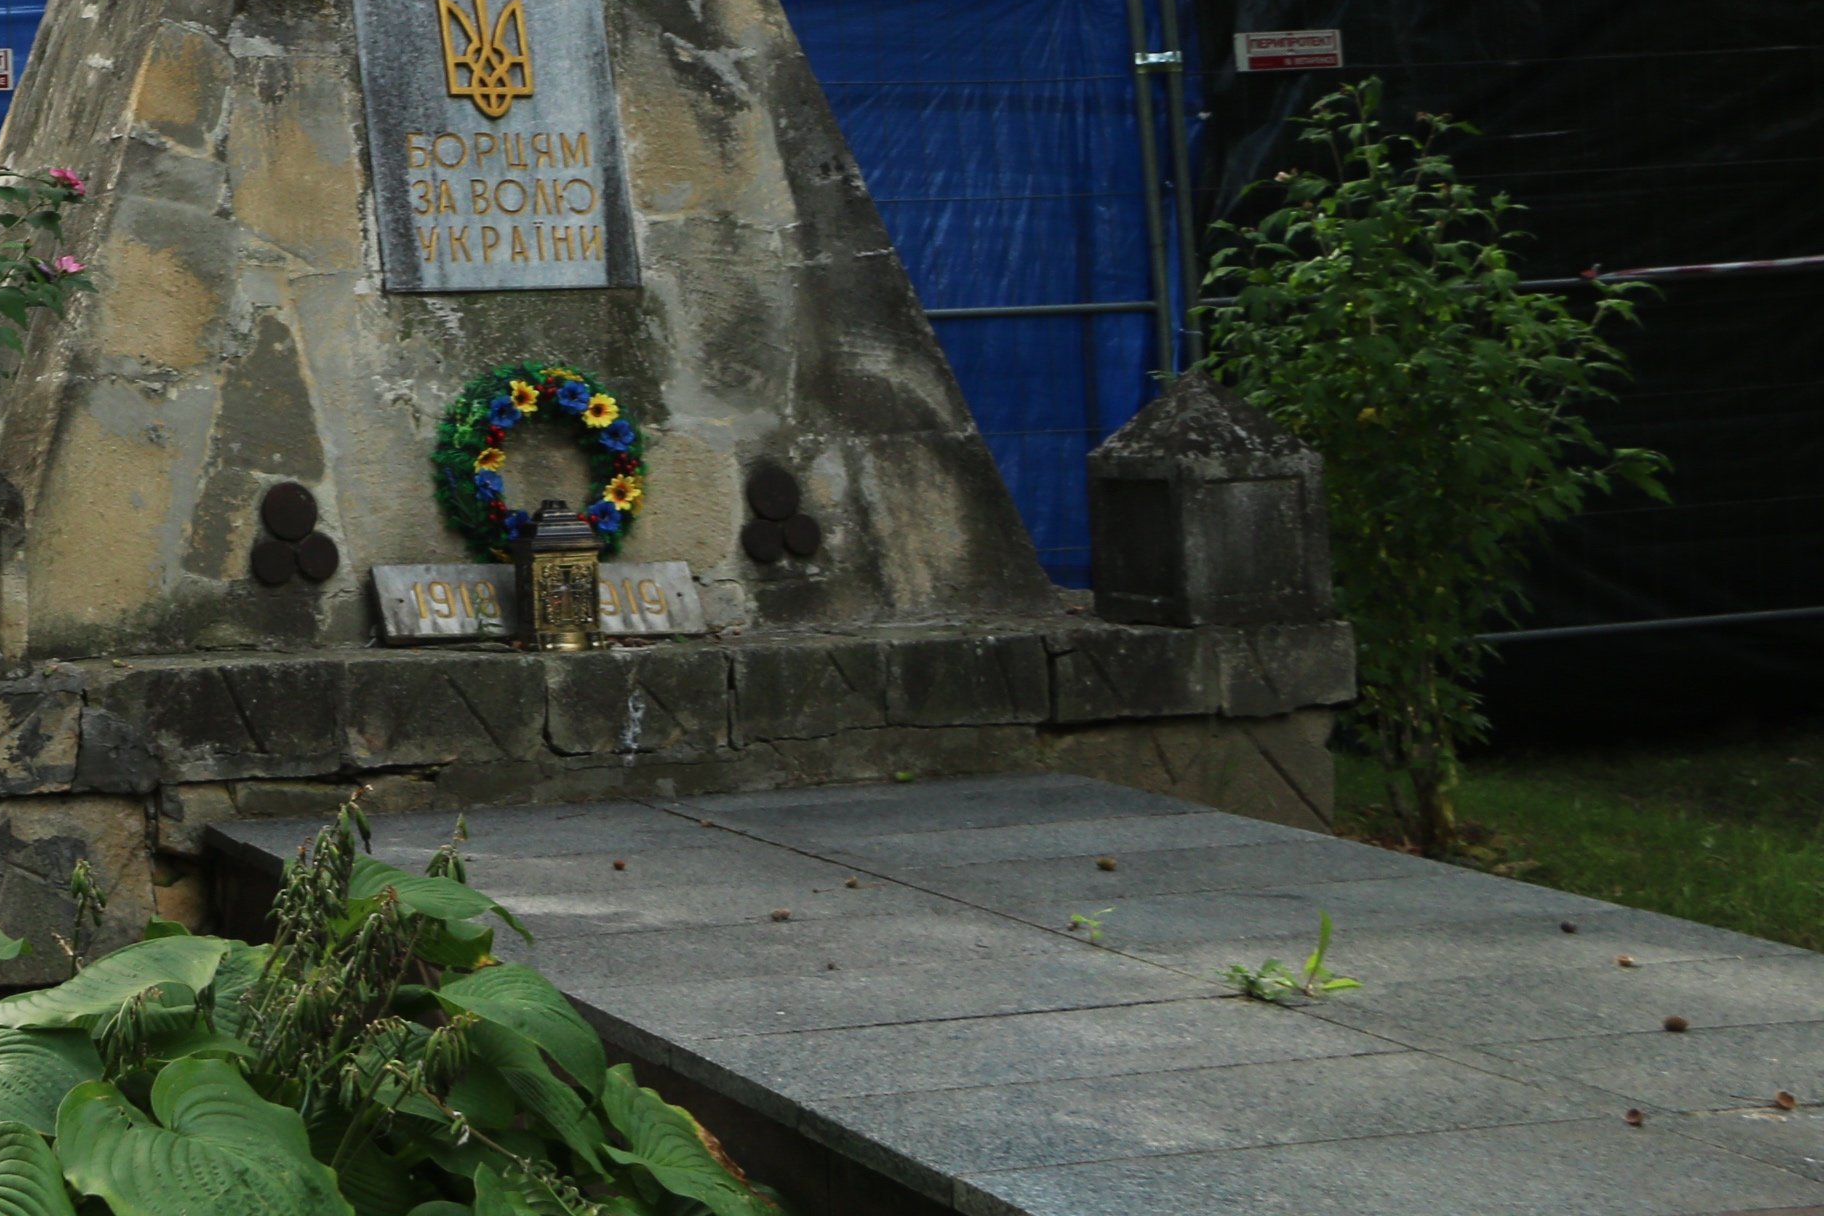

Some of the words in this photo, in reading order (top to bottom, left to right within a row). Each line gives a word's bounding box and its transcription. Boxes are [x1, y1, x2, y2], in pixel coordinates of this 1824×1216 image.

[406, 131, 592, 170] БОРЦЯМ
[412, 178, 457, 215] ЗА
[470, 178, 598, 215] ВОЛЮ
[416, 221, 605, 263] УКРАЇНИ
[412, 580, 502, 620] 1918
[598, 578, 668, 617] 919
